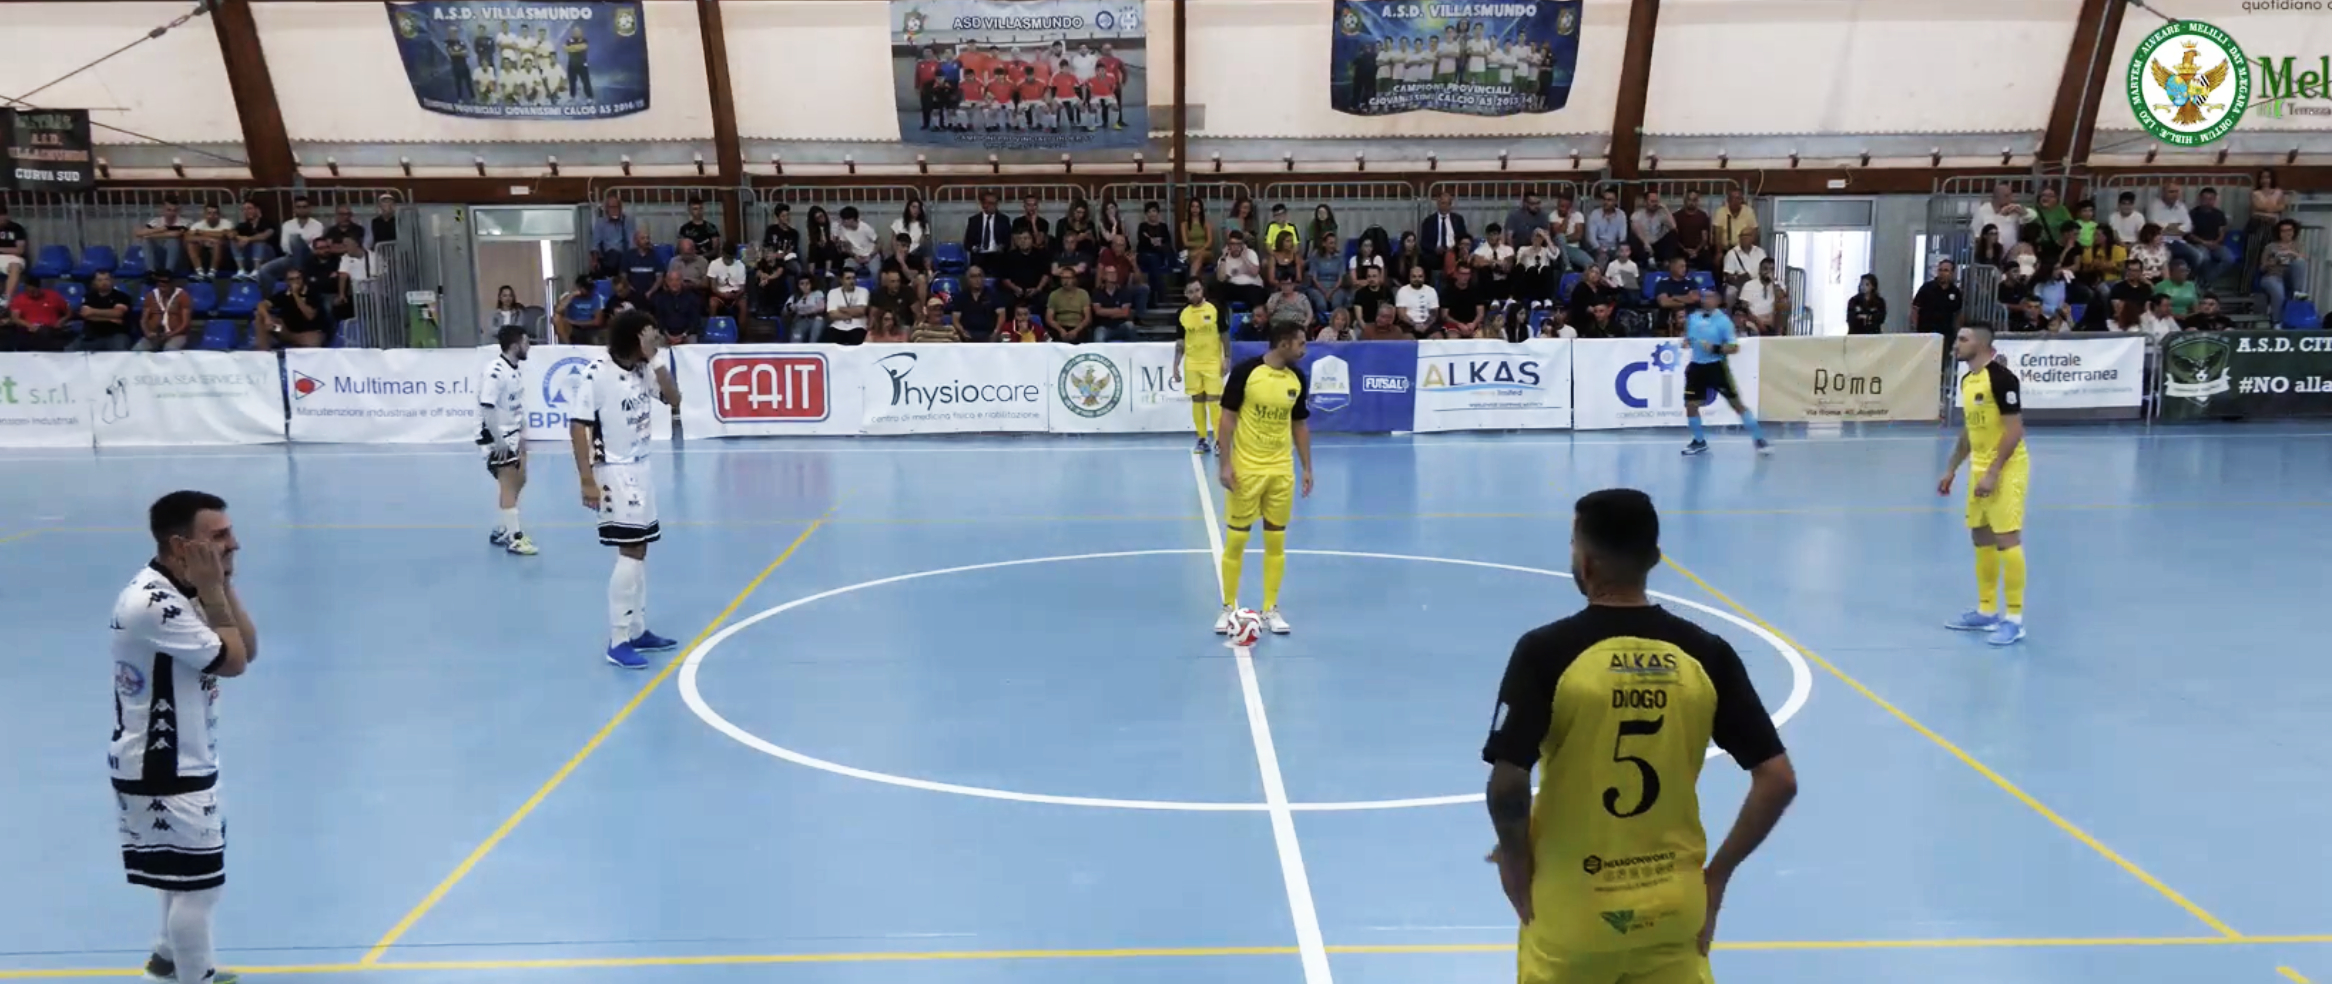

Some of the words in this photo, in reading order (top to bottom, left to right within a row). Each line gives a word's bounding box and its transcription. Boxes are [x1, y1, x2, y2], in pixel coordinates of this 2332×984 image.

[433, 7, 476, 20] A.S.D.
[482, 7, 593, 20] VILLASMUNDO
[1382, 5, 1424, 17] A.S.D.
[1430, 4, 1537, 18] VILLASMUNDO
[953, 16, 982, 30] ASD
[983, 16, 1084, 31] VILLASMUNDO
[1448, 83, 1512, 95] PROVINCIALI
[1438, 93, 1475, 105] CALCIO
[505, 105, 561, 117] GIOVANISSIMI
[564, 106, 596, 117] CALCIO
[14, 167, 54, 181] CURVA
[56, 171, 80, 182] SUD
[2236, 337, 2295, 352] A.S.D.
[2020, 353, 2081, 368] Centrale
[872, 352, 1040, 411] Physiocare
[1422, 360, 1541, 388] ALKAS
[1814, 368, 1883, 395] Roma
[2020, 369, 2118, 383] Mediterranea
[334, 376, 427, 395] Multiman
[434, 377, 475, 395] s.r.l.
[720, 363, 817, 410] FAIT
[1365, 377, 1404, 390] FUTSAL
[2238, 376, 2290, 394] #NO
[29, 382, 76, 404] s.r.l.
[446, 407, 475, 418] shore
[871, 414, 899, 424] centro
[901, 413, 911, 423] di
[912, 411, 951, 421] medicina
[953, 411, 975, 420] fisica
[984, 409, 1041, 420] riabilitazione
[1610, 652, 1678, 670] ALKAS
[1612, 689, 1668, 709] DIOGO
[1602, 714, 1665, 819] 5
